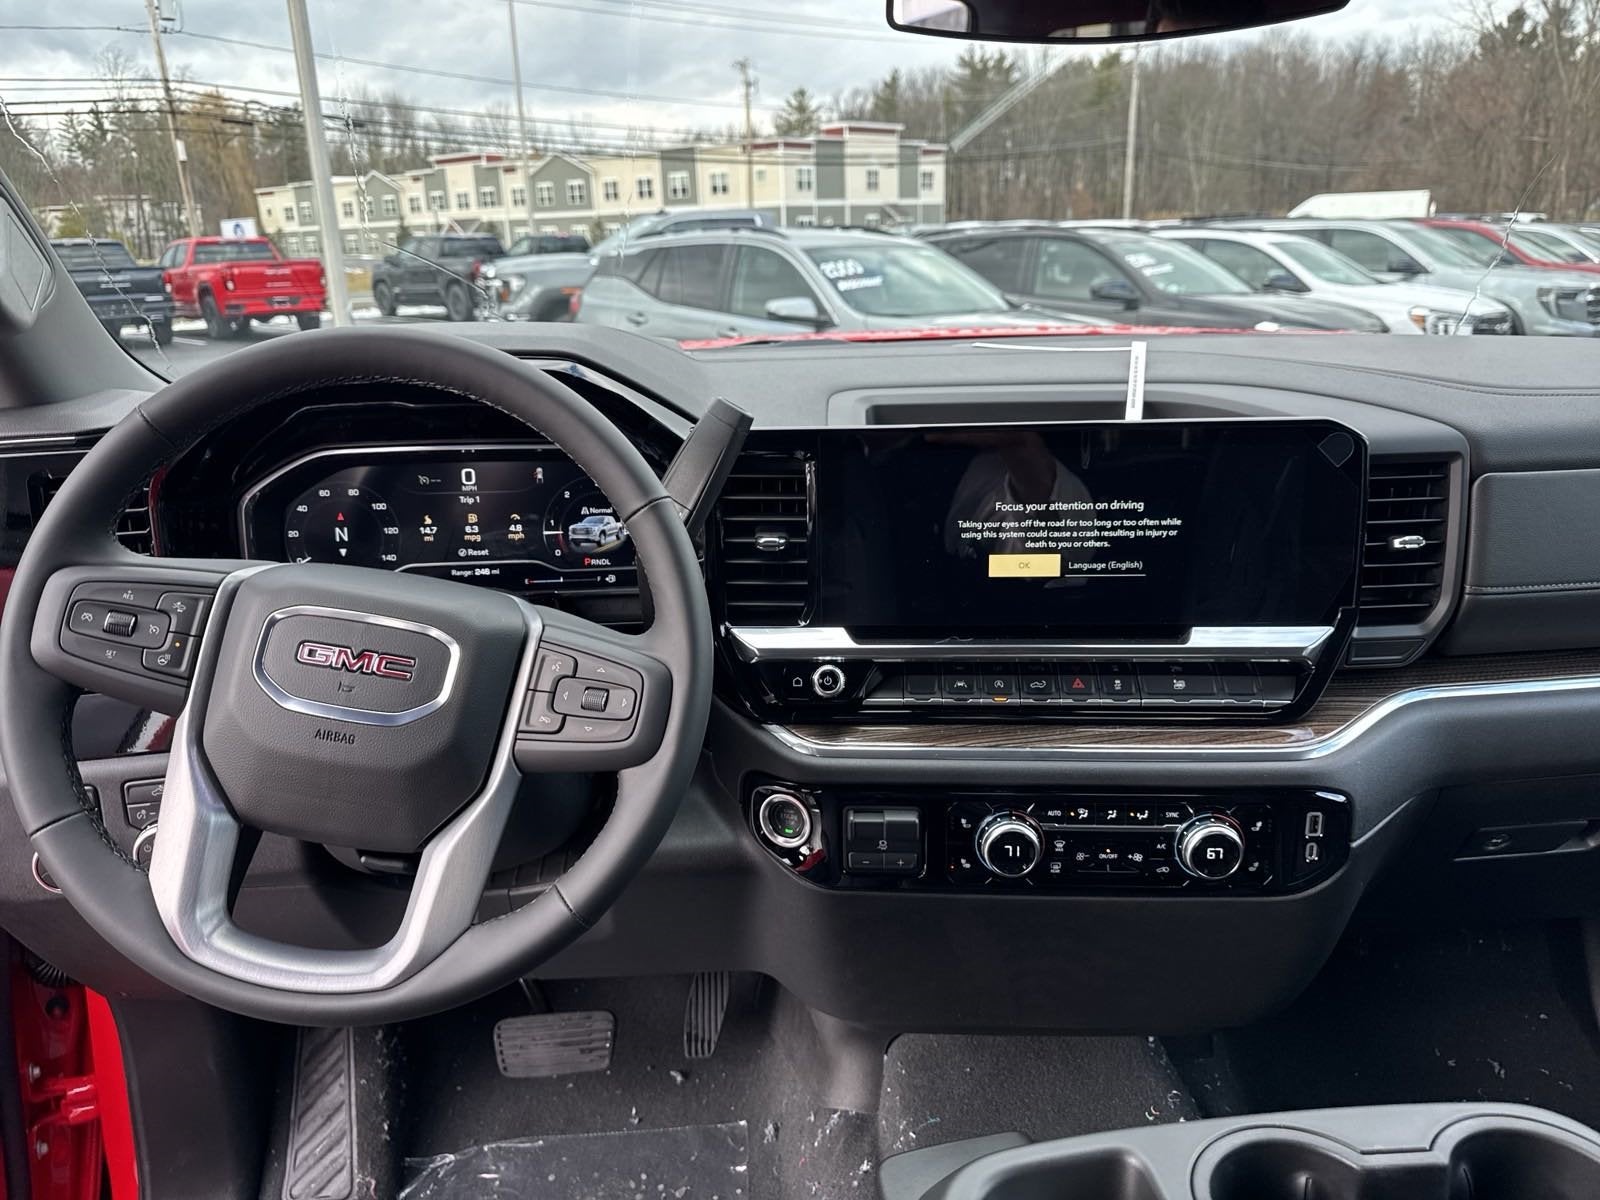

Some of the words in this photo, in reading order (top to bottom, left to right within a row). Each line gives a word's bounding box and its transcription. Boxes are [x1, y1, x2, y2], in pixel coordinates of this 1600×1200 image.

[461, 468, 476, 485] 0
[459, 496, 475, 504] Trip
[995, 502, 1024, 511] Focus
[1025, 503, 1047, 513] your
[1049, 502, 1094, 511] attention
[1095, 502, 1108, 510] on
[1110, 499, 1145, 512] driving
[958, 521, 982, 529] Taking
[983, 521, 1000, 529] your
[1002, 521, 1019, 529] eyes
[1020, 519, 1032, 527] off
[1047, 519, 1065, 527] road
[1079, 519, 1093, 527] too
[1094, 519, 1112, 528] long
[1138, 518, 1160, 526] often
[1161, 518, 1182, 526] while
[335, 527, 349, 542] N
[464, 534, 481, 542] mpg
[508, 532, 524, 540] mph
[961, 531, 982, 540] using
[999, 531, 1025, 539] system
[1026, 530, 1047, 538] could
[1079, 529, 1100, 537] crash
[1101, 529, 1135, 539] resulting
[1136, 529, 1144, 537] in
[1145, 529, 1167, 538] injury
[1025, 540, 1047, 548] death
[1048, 540, 1057, 548] to
[1058, 541, 1072, 549] you
[1083, 539, 1111, 548] others.
[382, 554, 397, 562] 140
[584, 558, 611, 566] PRNDL
[1068, 561, 1107, 571] Language
[1107, 560, 1143, 571] (English)
[451, 569, 474, 577] Range:
[122, 592, 135, 601] RES
[104, 649, 117, 657] SET
[297, 641, 417, 682] GMC
[314, 728, 356, 745] AIRBAG
[1003, 845, 1021, 857] 71
[1206, 848, 1224, 859] 67
